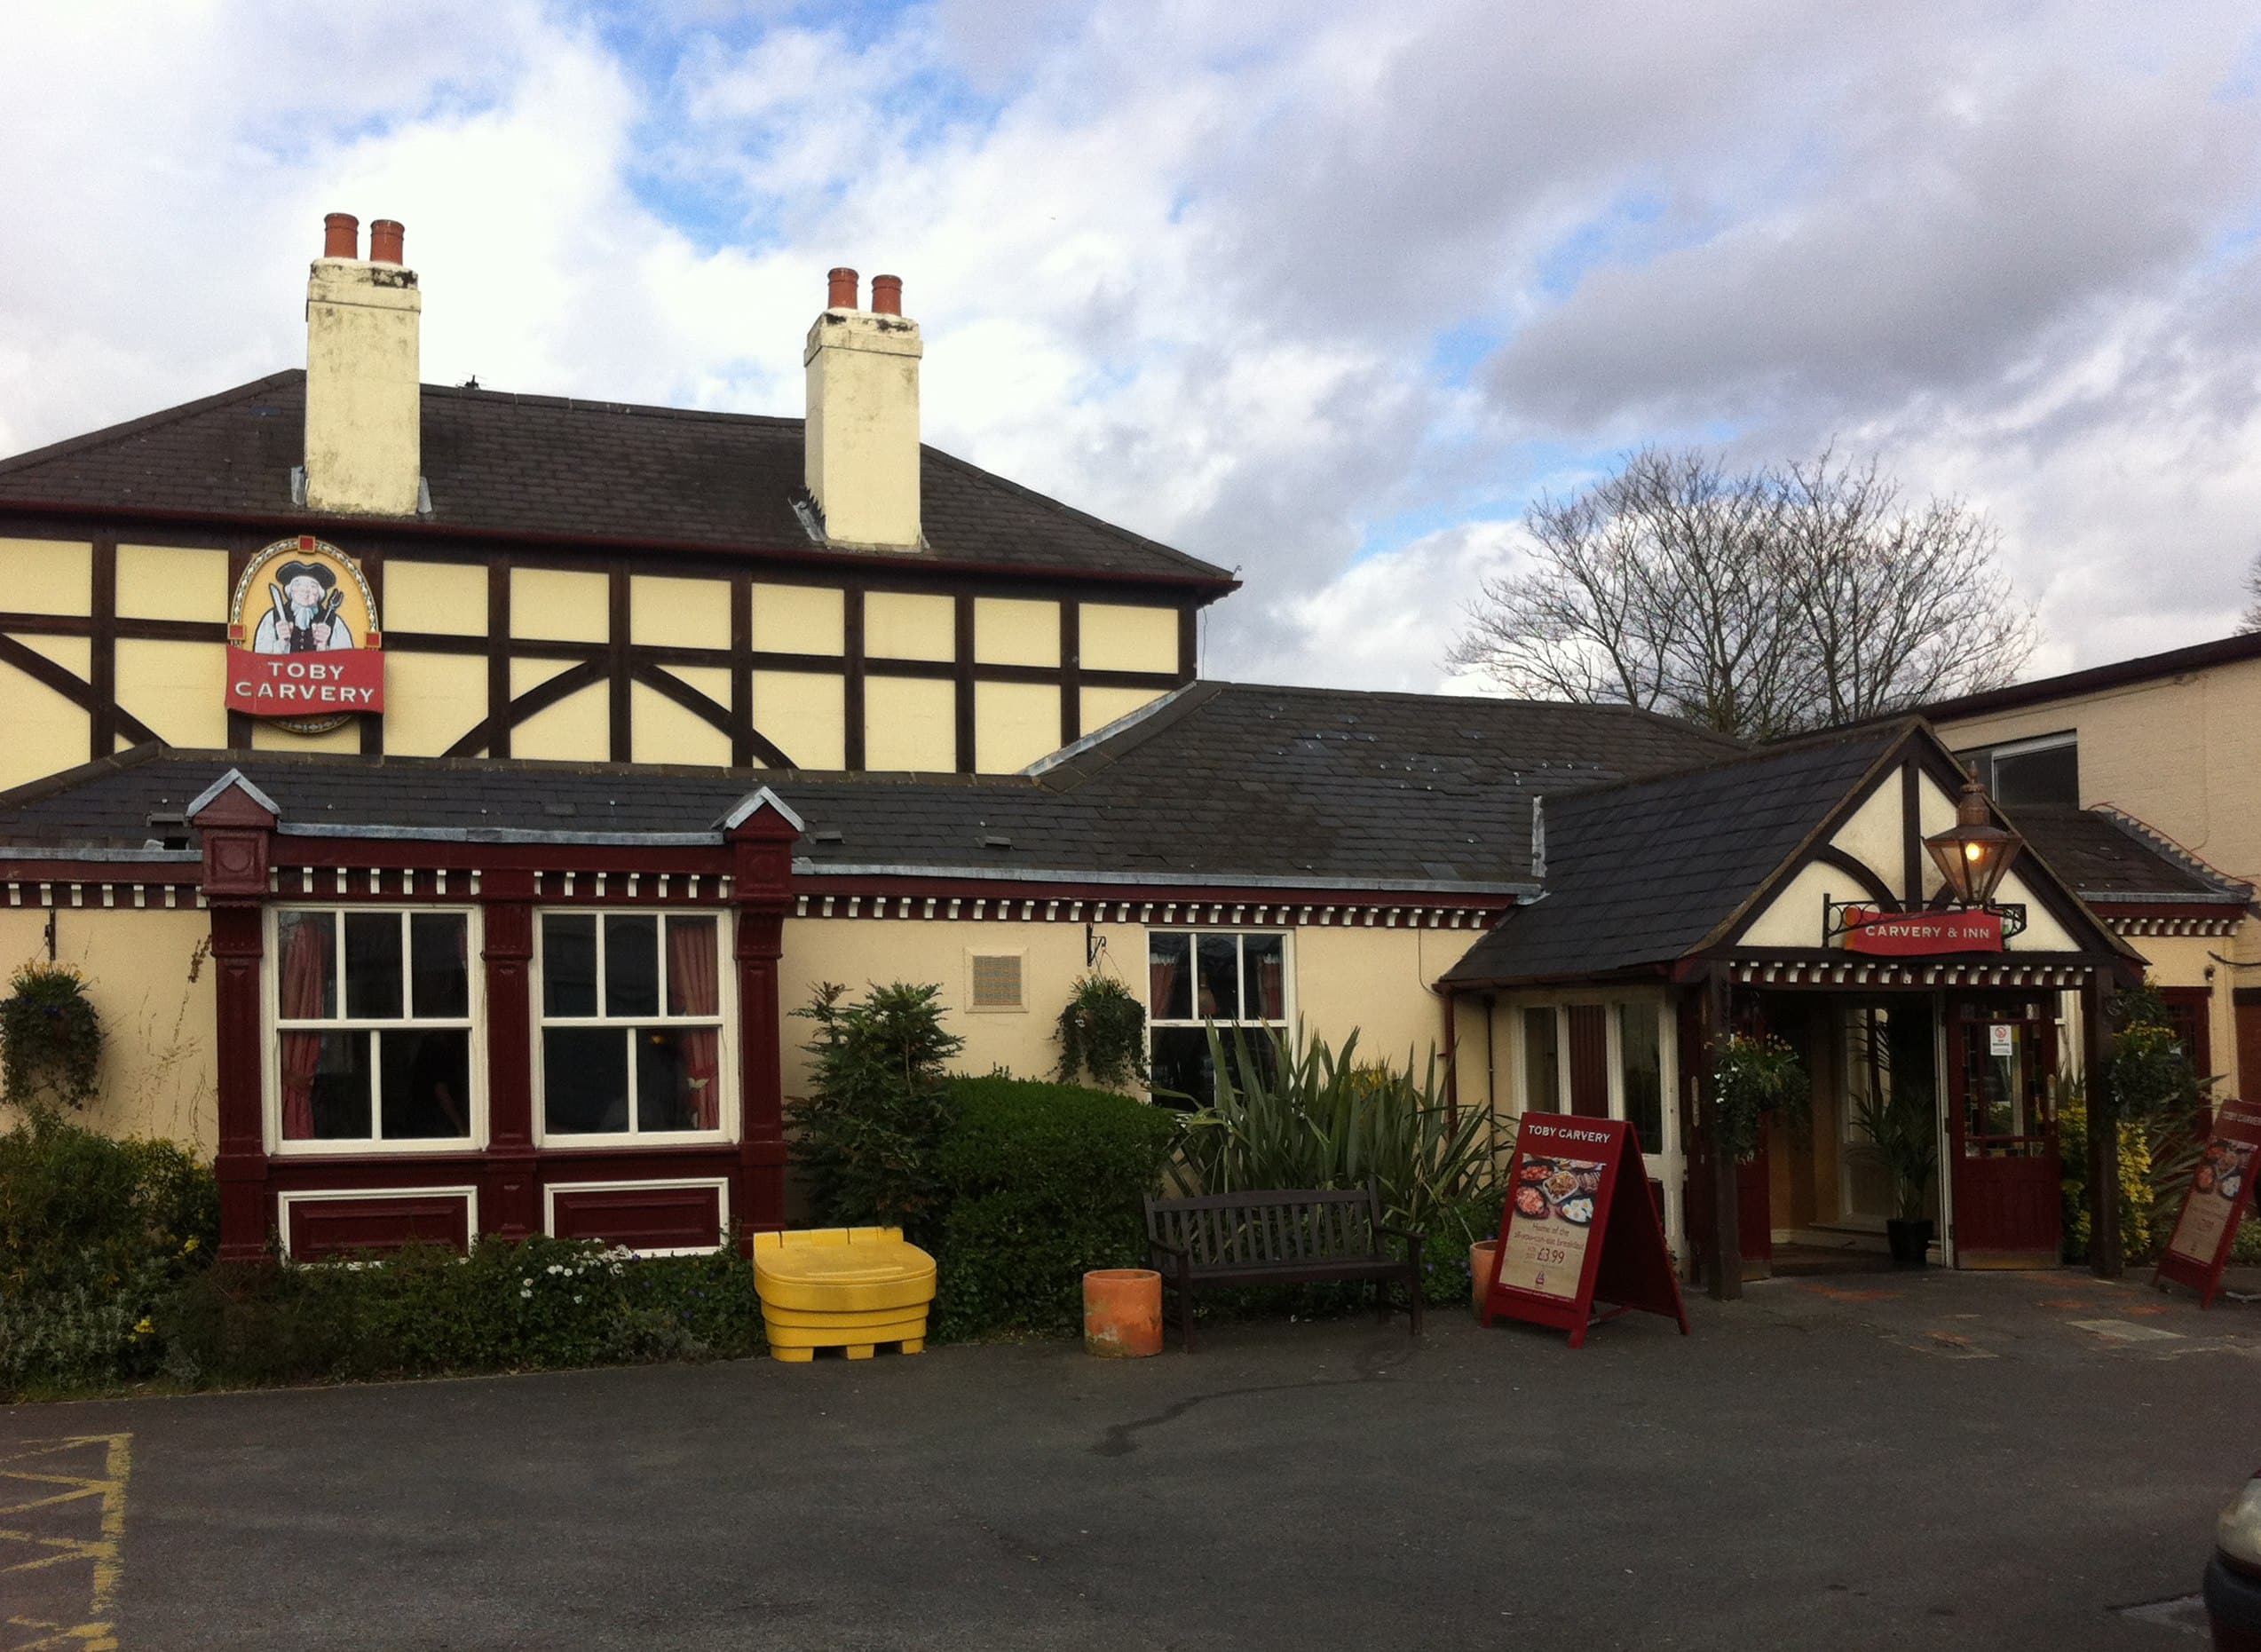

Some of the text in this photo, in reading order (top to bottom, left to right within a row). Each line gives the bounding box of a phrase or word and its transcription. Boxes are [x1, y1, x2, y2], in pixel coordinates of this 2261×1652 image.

[267, 661, 344, 680] TOBY
[234, 681, 375, 704] CARVERY
[1865, 925, 1989, 938] CARVERY & INN
[1528, 1125, 1610, 1143] TOBY CARVERY
